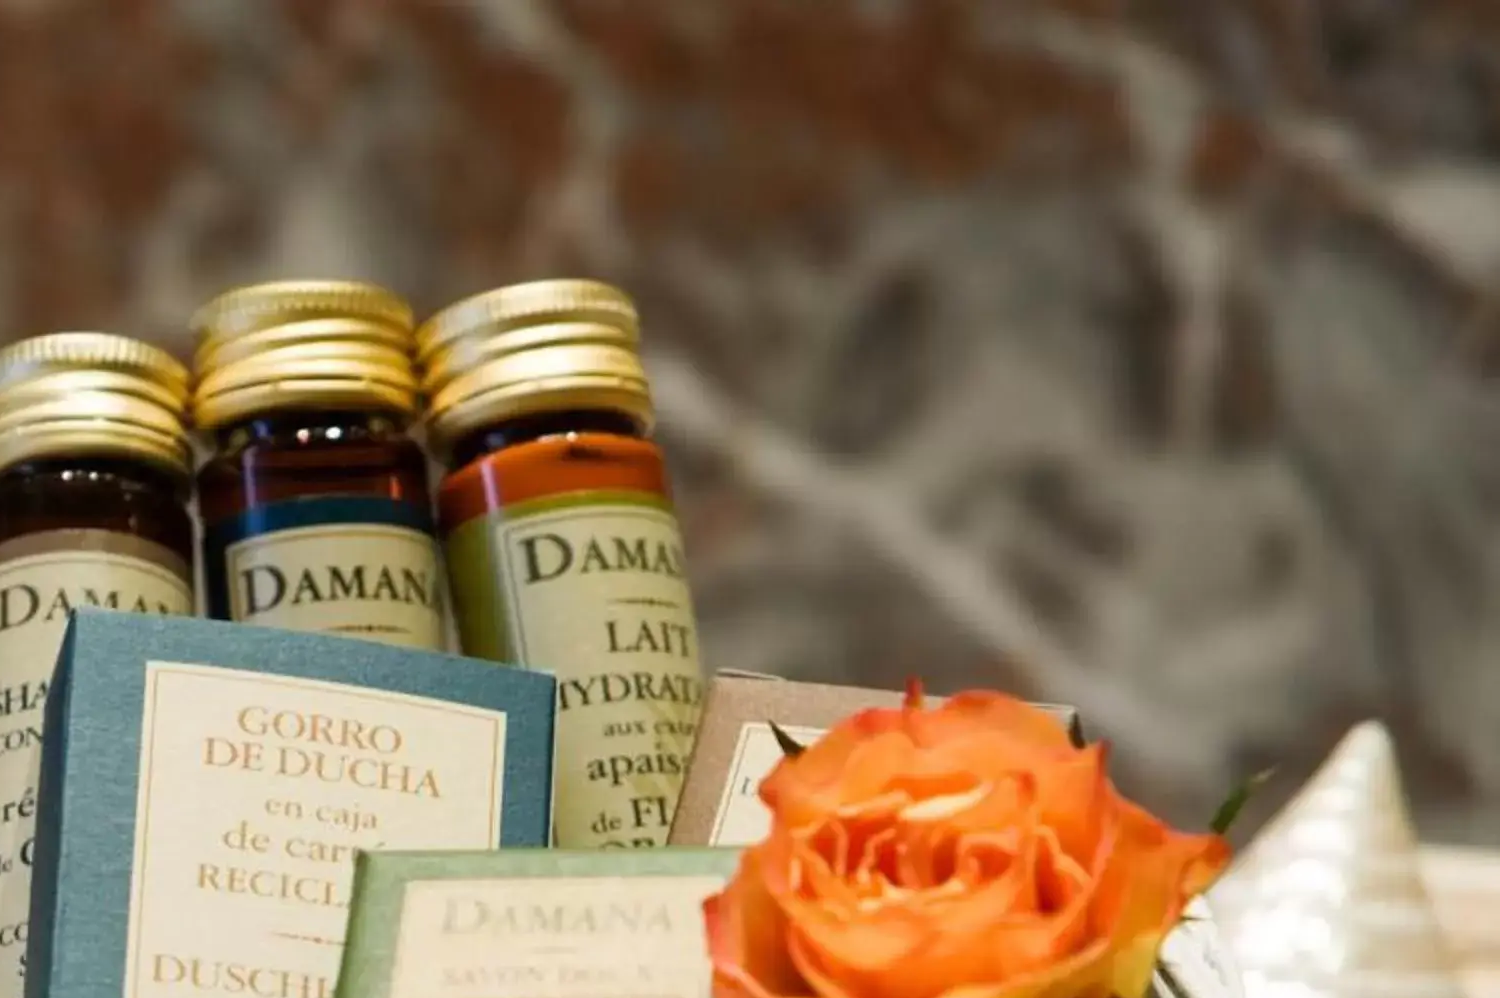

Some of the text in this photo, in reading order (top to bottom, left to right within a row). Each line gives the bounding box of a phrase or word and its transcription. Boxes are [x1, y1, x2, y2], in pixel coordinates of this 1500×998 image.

[605, 620, 690, 658] LAIT
[560, 672, 701, 710] YDRAT
[237, 706, 402, 754] GORRO
[603, 720, 647, 737] aux
[203, 737, 442, 798] DE DUCHA
[587, 742, 687, 786] apais
[2, 787, 35, 822] ré
[265, 798, 377, 833] en caja
[591, 811, 622, 833] de
[222, 820, 386, 864] de car
[441, 900, 673, 935] DAMANA
